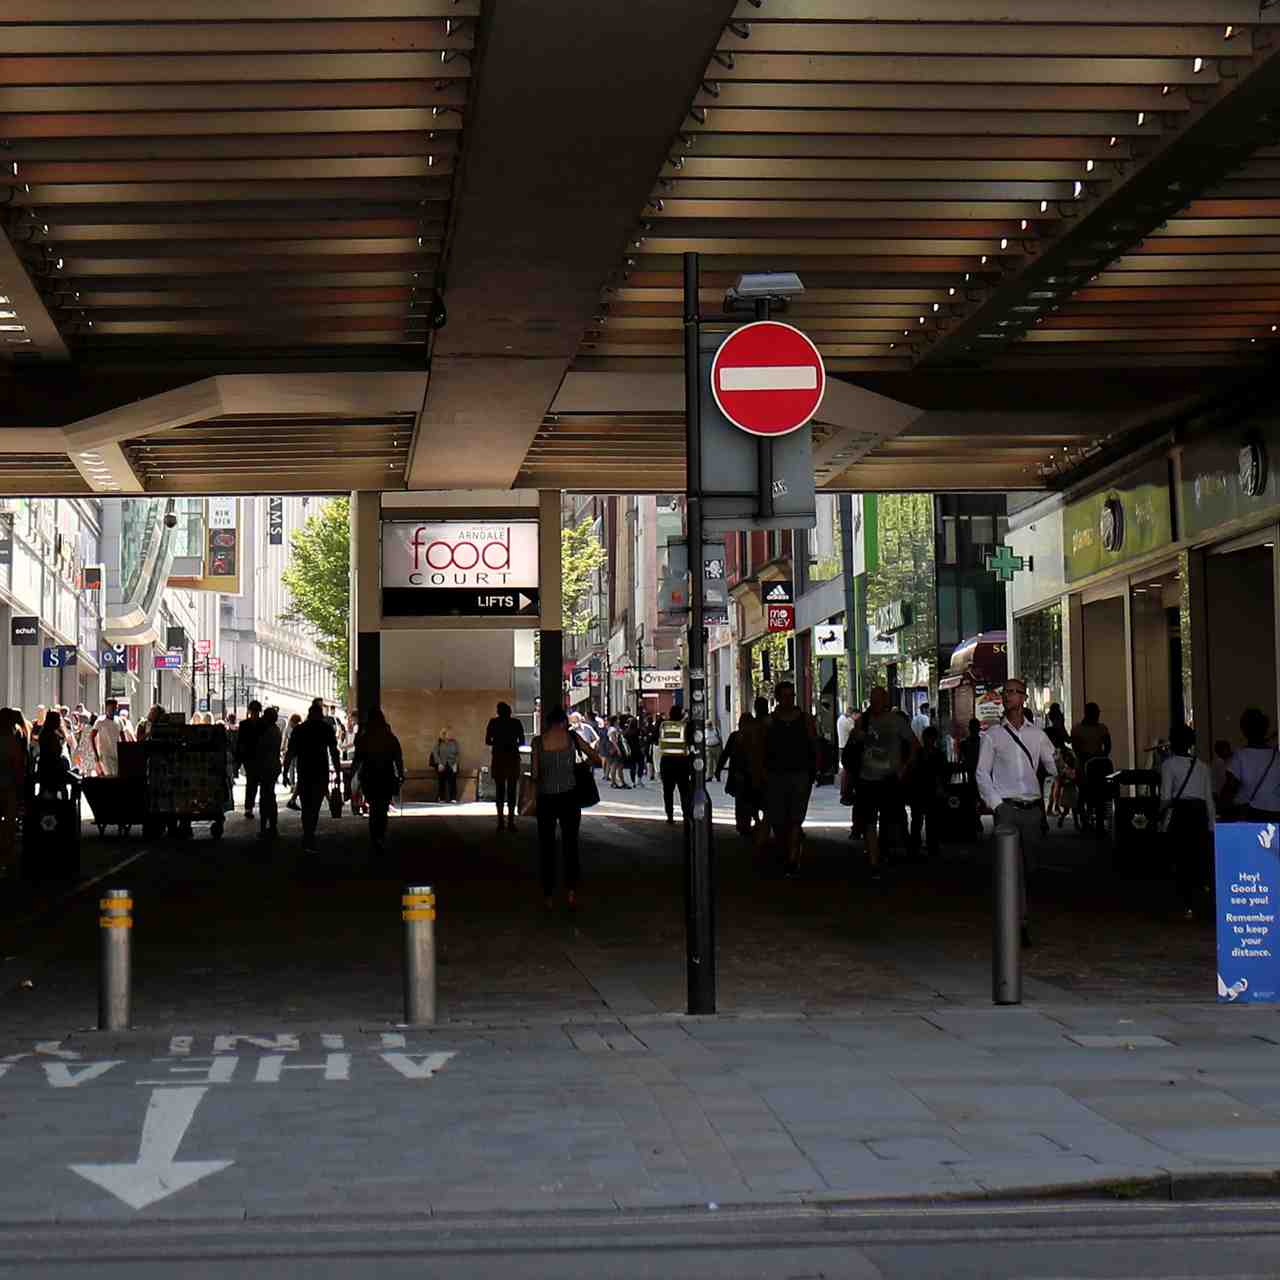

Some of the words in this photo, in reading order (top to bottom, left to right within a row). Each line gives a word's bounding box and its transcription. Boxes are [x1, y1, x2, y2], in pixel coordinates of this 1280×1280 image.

[458, 530, 504, 540] ARNDALE
[411, 527, 511, 570] food
[408, 572, 512, 585] COURT
[477, 595, 514, 607] LIFTS
[1238, 871, 1261, 884] Hey!
[1231, 883, 1257, 893] Good
[1259, 883, 1269, 893] to
[1231, 896, 1246, 905] see
[1248, 896, 1269, 907] you!
[1226, 912, 1274, 923] Remember
[1233, 925, 1244, 934] to
[1246, 924, 1268, 936] keep
[1240, 938, 1263, 947] your
[1231, 947, 1272, 958] distance.
